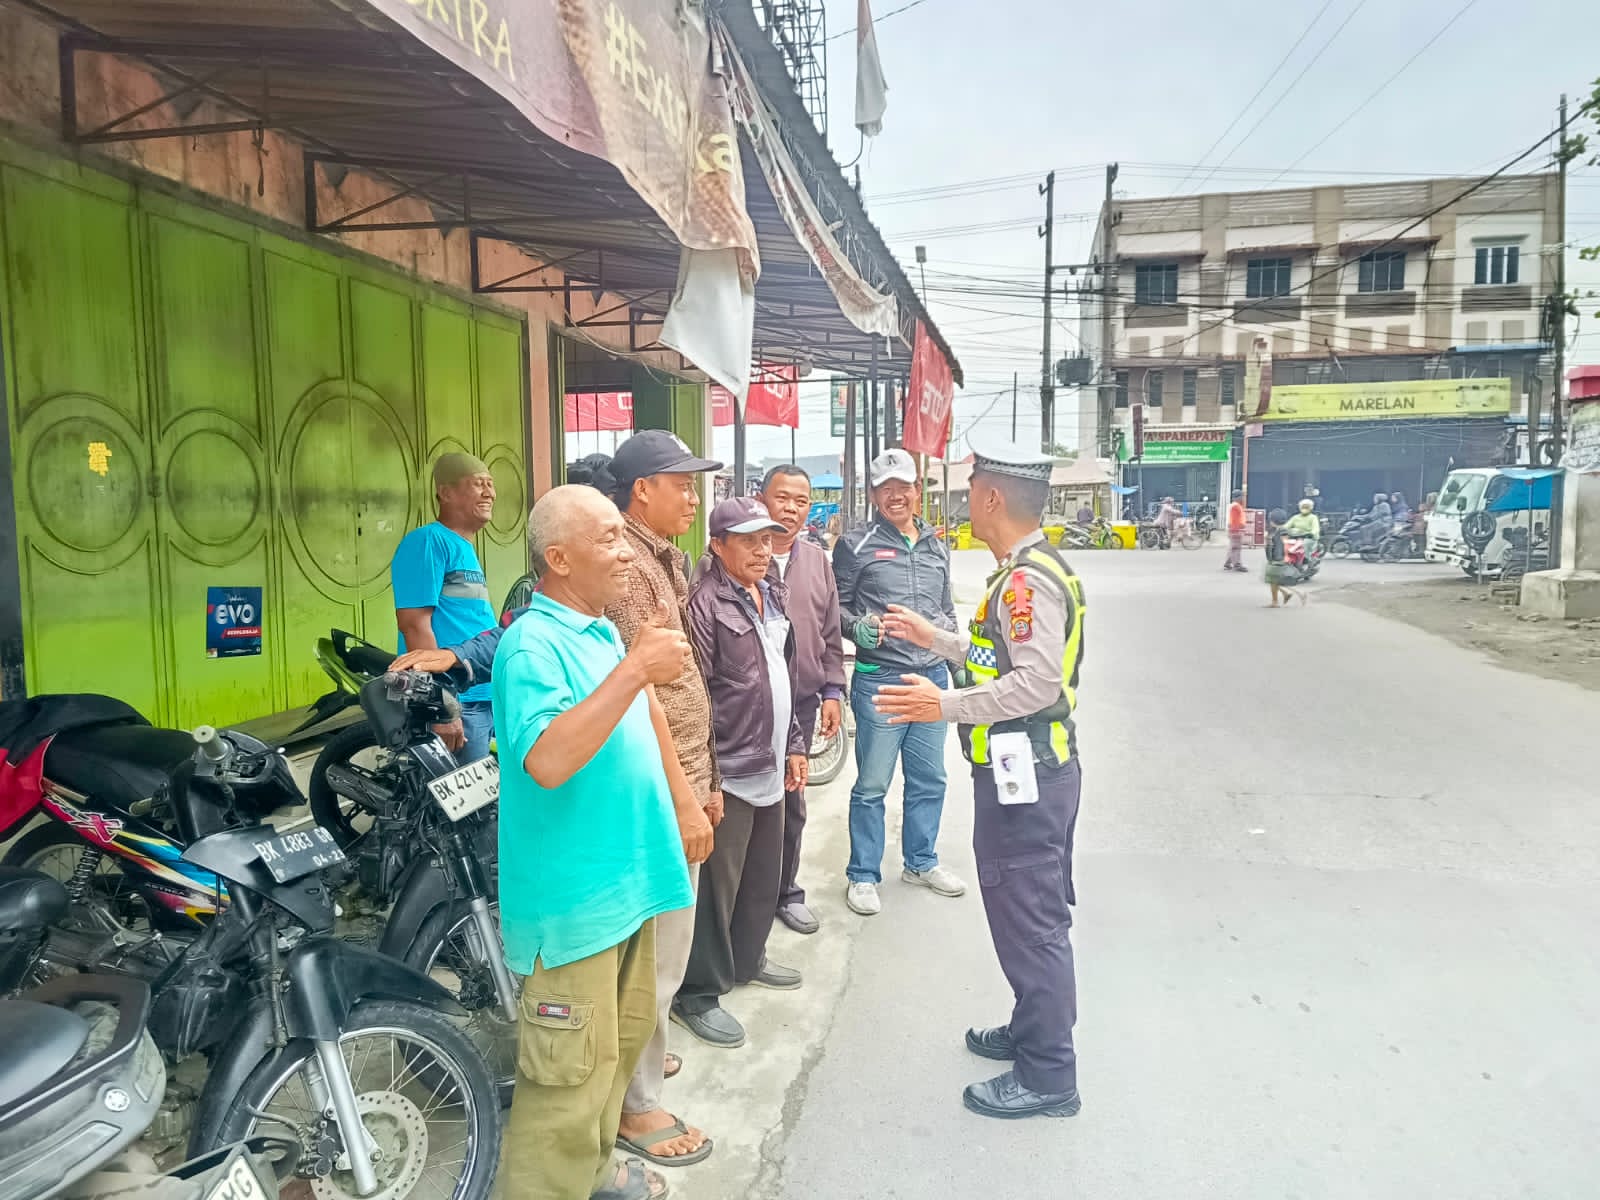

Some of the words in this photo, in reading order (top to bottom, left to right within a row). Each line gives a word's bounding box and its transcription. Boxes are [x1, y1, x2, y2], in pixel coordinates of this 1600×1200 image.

[1339, 396, 1416, 412] MARELAN
[1158, 431, 1226, 442] SPAREPART
[215, 603, 255, 625] evo
[433, 779, 455, 801] BK
[454, 766, 483, 790] 4214
[254, 840, 281, 863] BK
